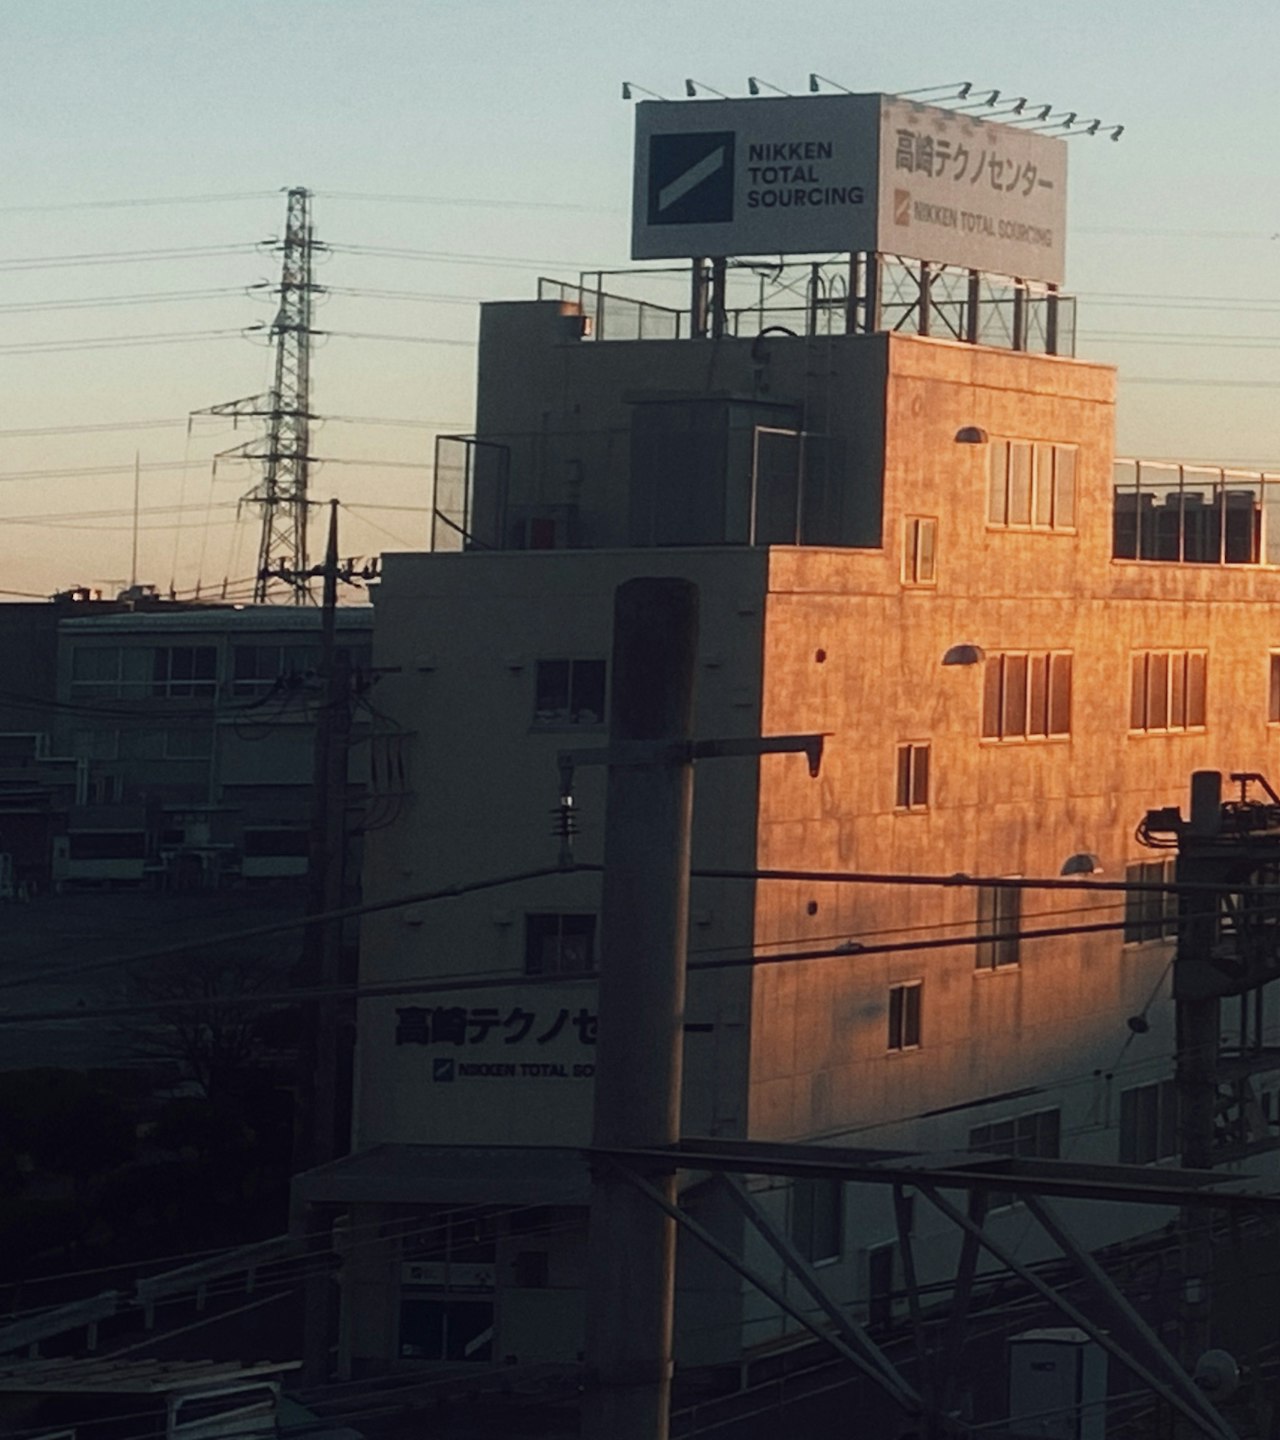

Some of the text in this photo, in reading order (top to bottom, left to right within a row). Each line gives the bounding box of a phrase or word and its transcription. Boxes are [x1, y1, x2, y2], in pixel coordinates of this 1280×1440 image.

[749, 142, 832, 161] NIKKEN
[896, 129, 1053, 196] 高崎テクノセンター
[748, 166, 819, 184] TOTAL
[747, 187, 864, 208] SOURCING
[914, 201, 1053, 247] NIKKEN TOTAL SOURCING
[520, 1063, 567, 1077] TOTAL
